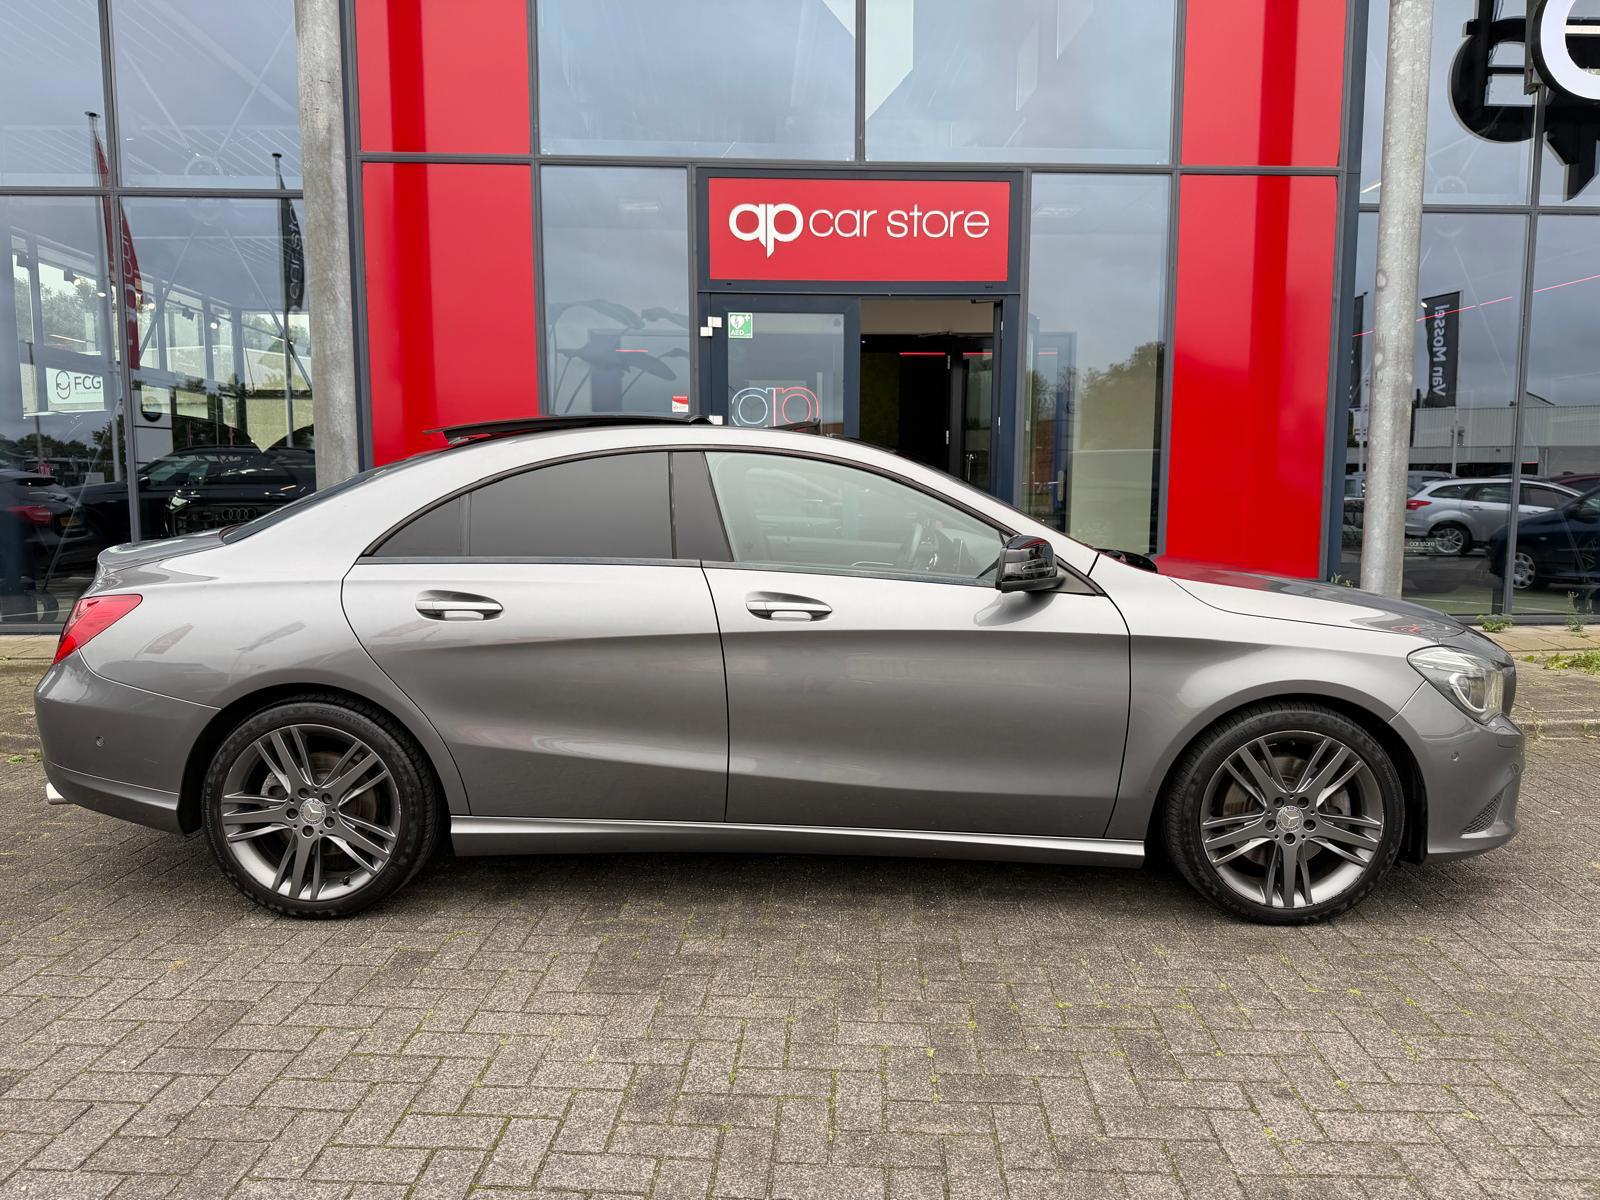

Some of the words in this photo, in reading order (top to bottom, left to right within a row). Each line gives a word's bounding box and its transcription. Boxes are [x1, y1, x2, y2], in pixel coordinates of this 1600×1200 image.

[809, 209, 877, 237] car
[886, 204, 990, 238] store
[74, 376, 102, 390] FCG
